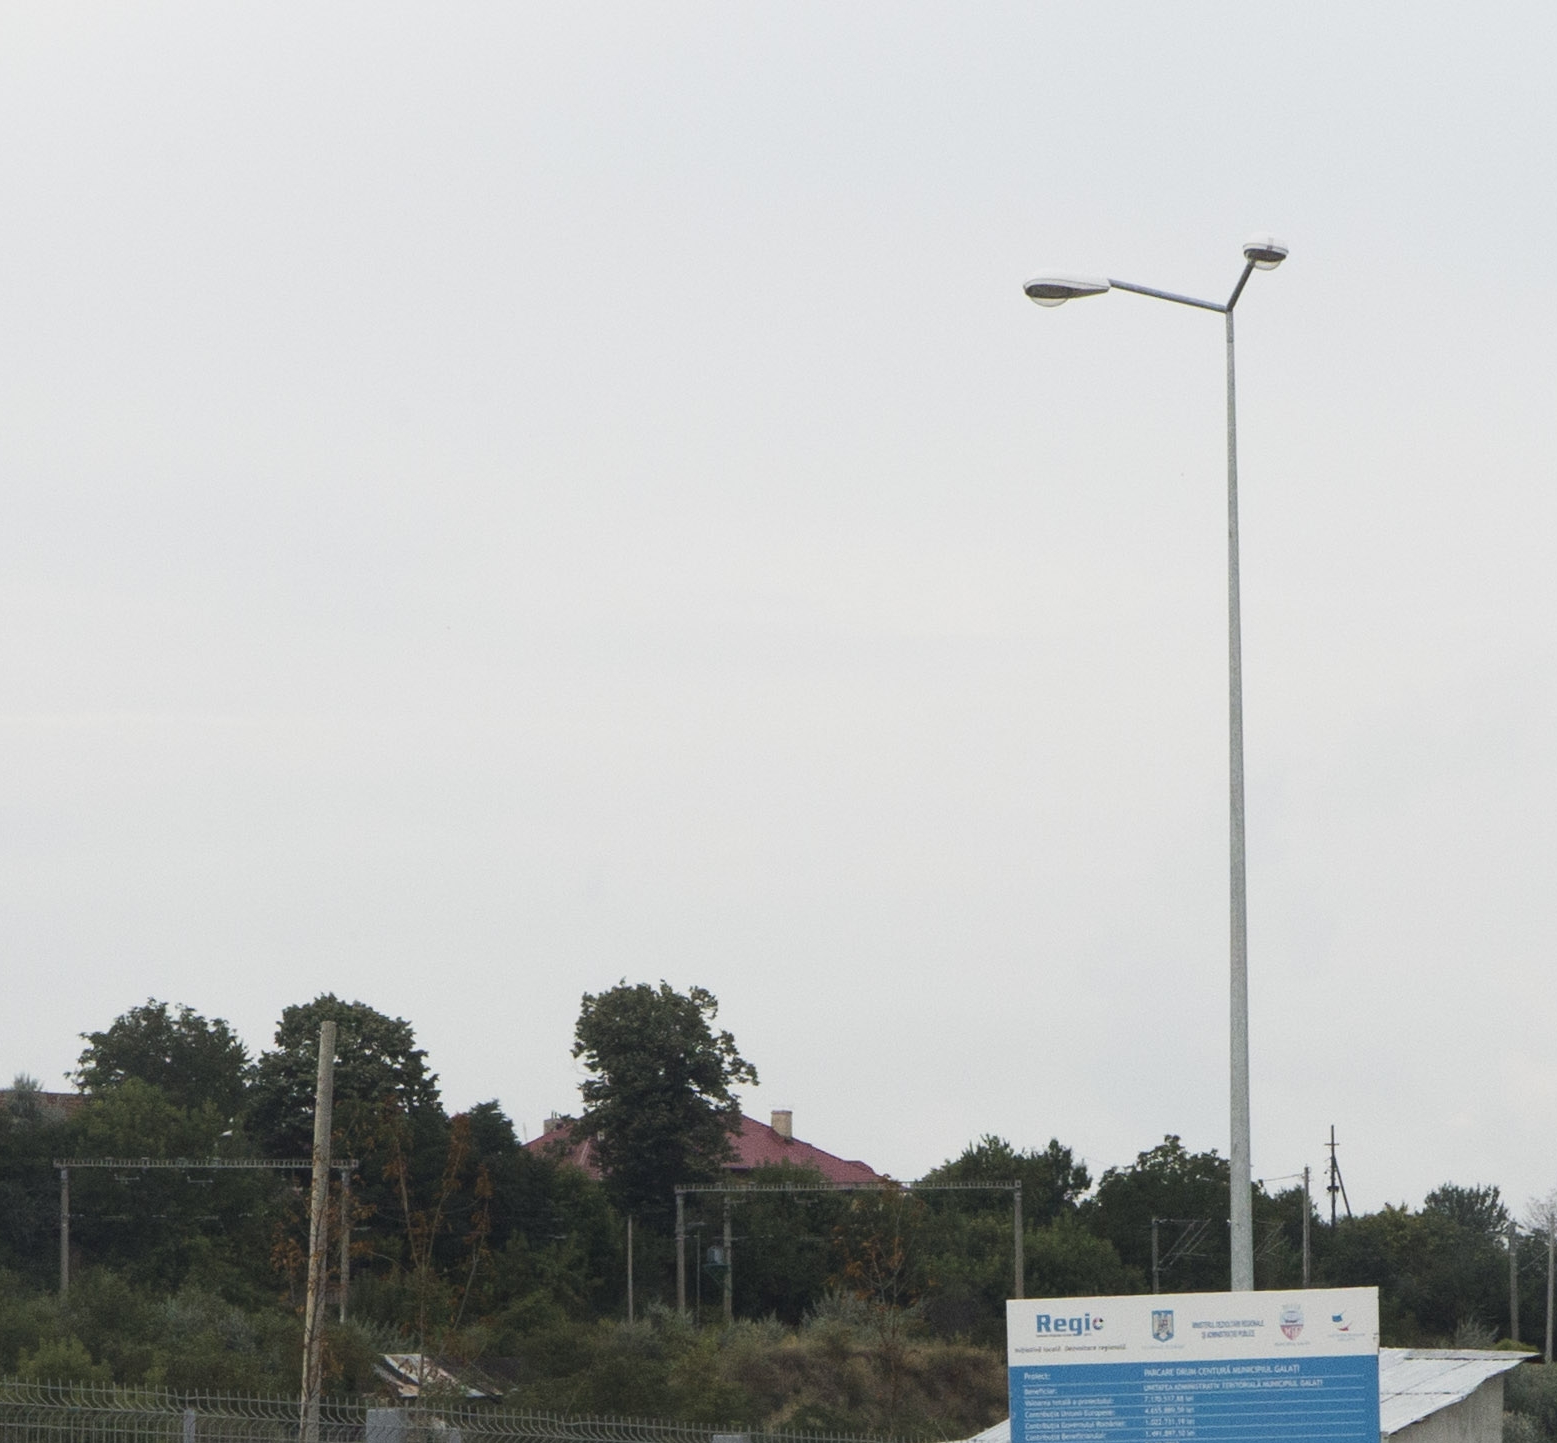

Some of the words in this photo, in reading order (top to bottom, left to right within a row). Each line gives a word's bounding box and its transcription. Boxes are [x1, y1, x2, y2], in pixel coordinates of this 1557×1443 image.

[1036, 1313, 1104, 1336] Regio
[1024, 1372, 1051, 1380] Proiect:
[1144, 1368, 1174, 1377] PARCARE
[1176, 1367, 1196, 1376] DRUM
[1232, 1365, 1273, 1375] MUNICIPIUL
[1143, 1383, 1173, 1392] UNITATEA
